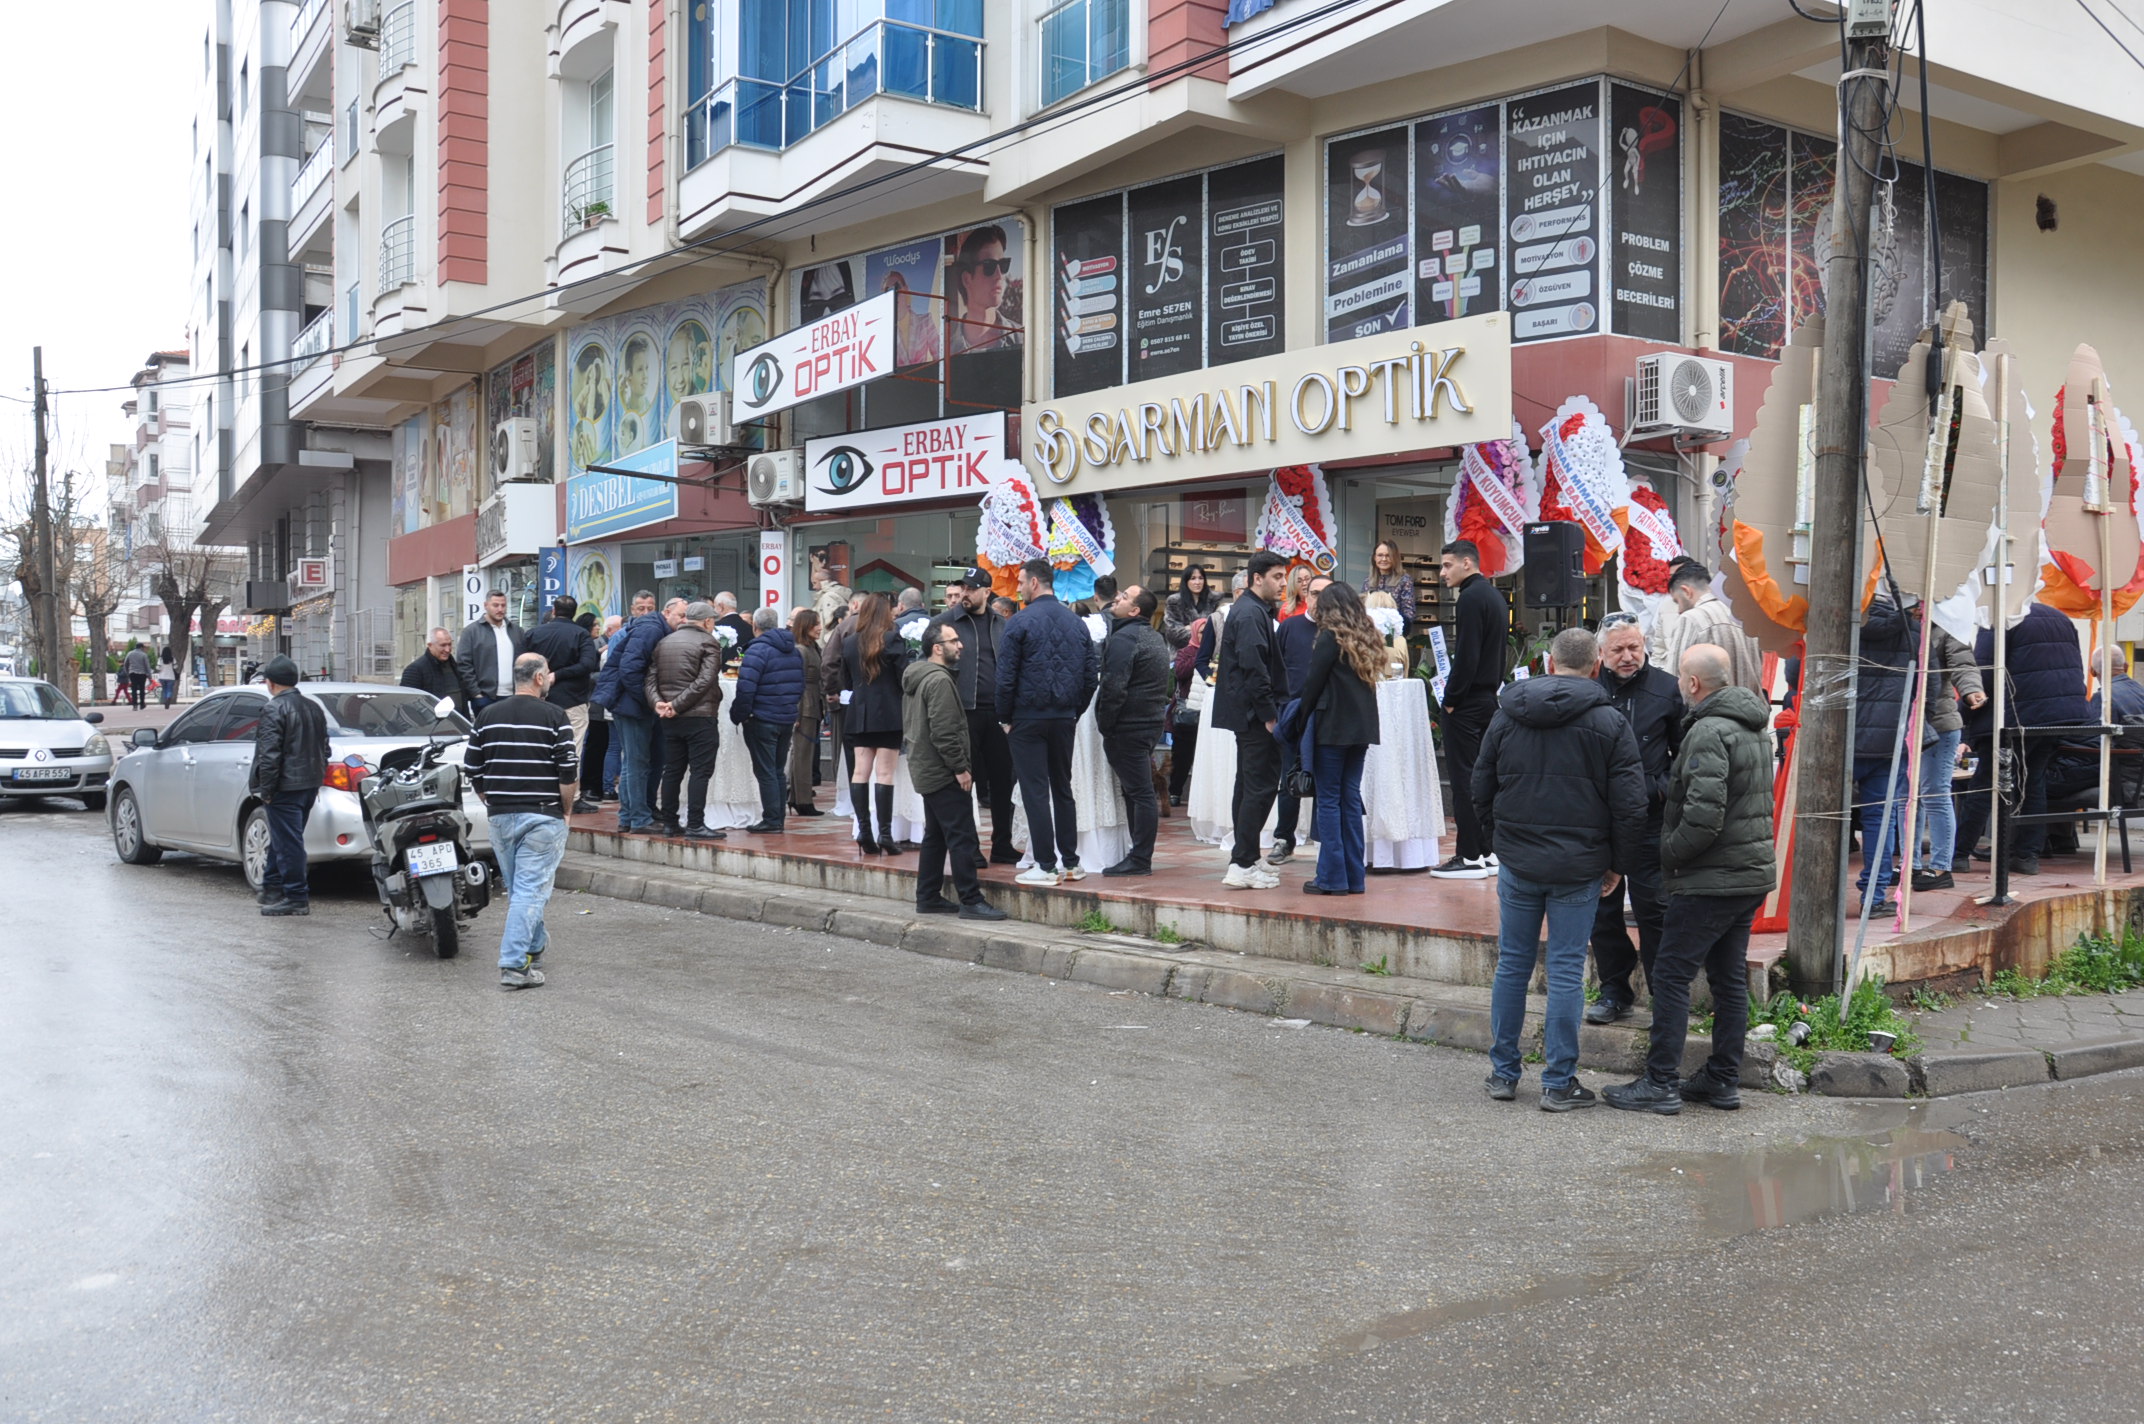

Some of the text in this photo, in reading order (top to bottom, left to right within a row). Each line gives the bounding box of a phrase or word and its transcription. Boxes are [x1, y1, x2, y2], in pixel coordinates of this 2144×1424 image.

[1533, 168, 1571, 188] OLAN
[1539, 214, 1586, 228] PERFORMANS
[1621, 232, 1670, 252] PROBLEM
[884, 251, 921, 267] Woodys
[1240, 248, 1256, 257] ÖDEV
[1332, 243, 1404, 277] Zamanlama
[1628, 260, 1664, 279] ÇÖZME
[1240, 284, 1256, 293] SINAV
[1334, 280, 1402, 311] Problemine
[1539, 282, 1571, 293] ÖZGÜVEN
[1616, 288, 1674, 309] BECERİLERİ
[1138, 301, 1192, 319] Emre SE7EN
[1137, 313, 1193, 329] Eğitim Danışmanlık
[1250, 320, 1264, 329] ÖZEL
[1355, 319, 1381, 338] SON
[1532, 319, 1558, 328] BAŞARI
[812, 310, 860, 353] ERBAY
[1228, 332, 1244, 341] YAYIN
[1083, 340, 1474, 467] SARMAN OPTİK
[903, 424, 968, 457] ERBAY
[1479, 475, 1525, 535] KUYUMCULU
[1570, 474, 1617, 535] MİMARLIK
[1385, 514, 1427, 528] TOM FORD
[1565, 485, 1610, 543] BALABAN
[761, 542, 783, 550] ERBAY
[1073, 525, 1101, 558] SİGORTA
[1283, 517, 1316, 559] TUNCA
[306, 564, 321, 581] E
[19, 769, 70, 778] 45 AFR 552
[410, 848, 424, 859] 45
[421, 858, 443, 870] 365
